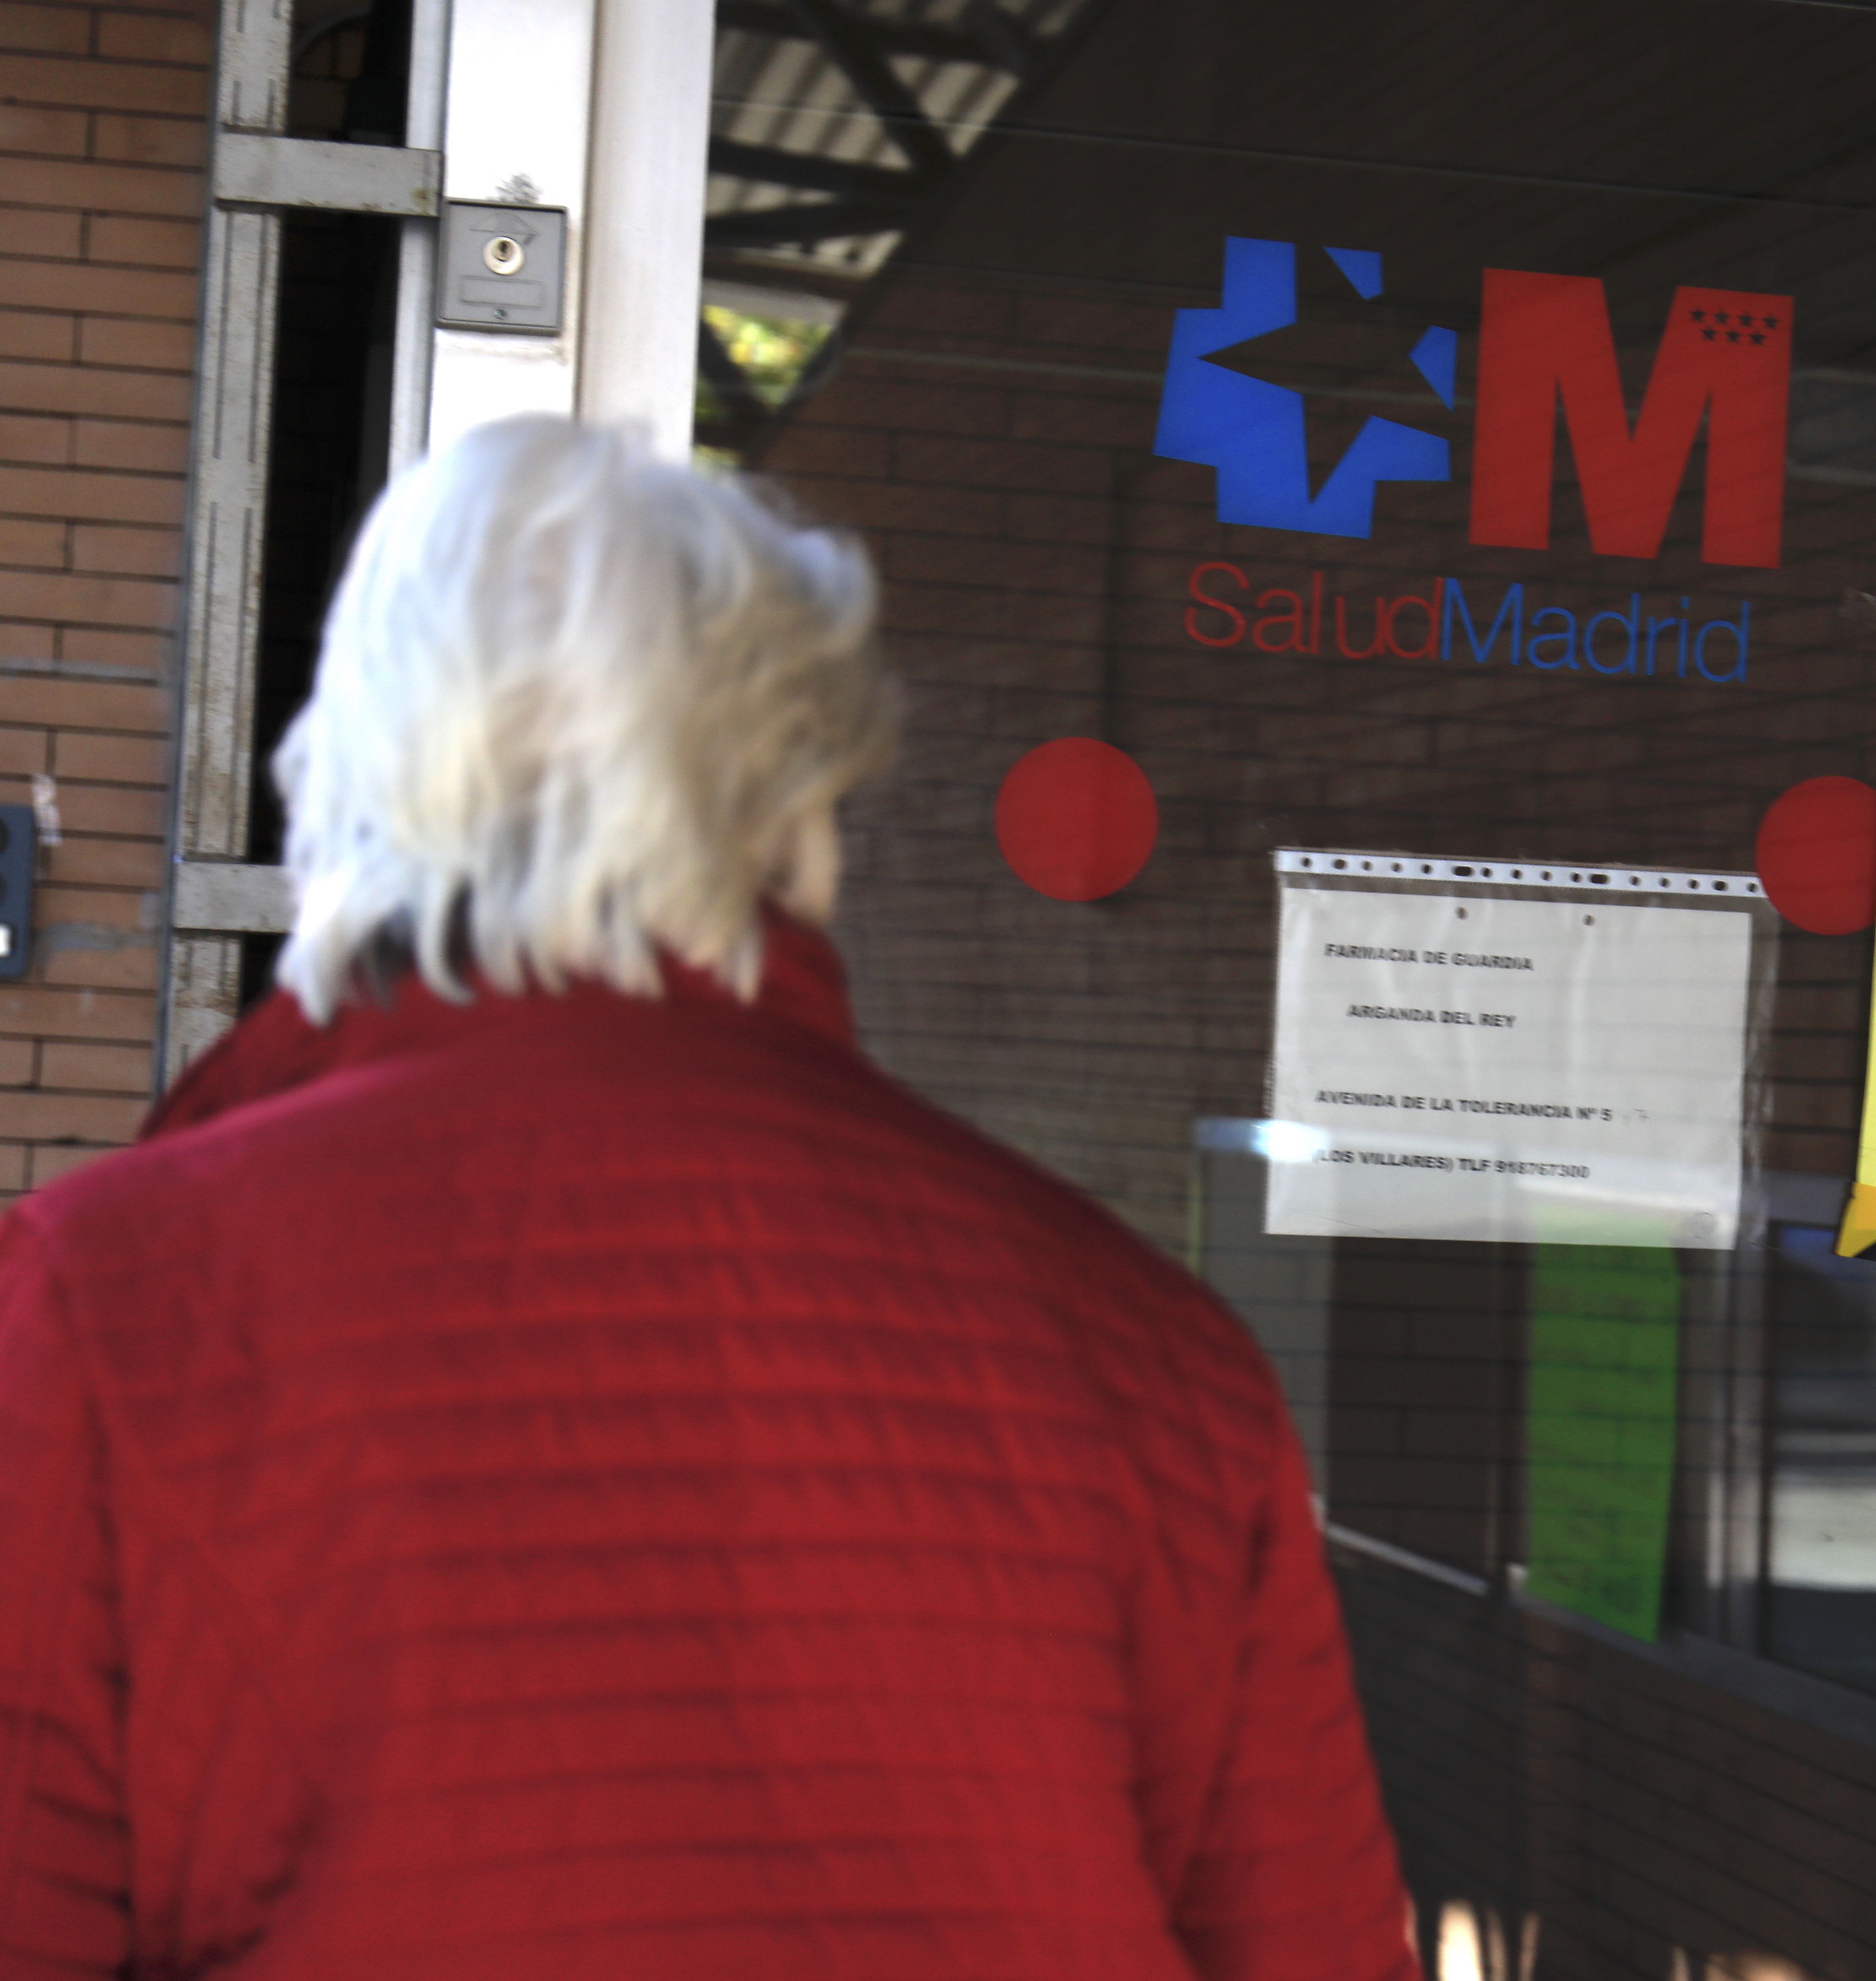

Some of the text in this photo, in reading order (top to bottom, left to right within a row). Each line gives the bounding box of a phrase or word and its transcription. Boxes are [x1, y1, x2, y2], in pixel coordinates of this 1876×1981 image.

[1324, 943, 1534, 970] FARMACIA DE GUARDIA
[1347, 1004, 1517, 1028] ARGANDA DEL REY
[1314, 1090, 1397, 1108] AVENIDA
[1401, 1095, 1425, 1110] DE
[1429, 1097, 1454, 1111] LA
[1458, 1099, 1573, 1119] TOLERANCIA
[1600, 1109, 1613, 1121] 5
[1457, 1157, 1491, 1172] TLF
